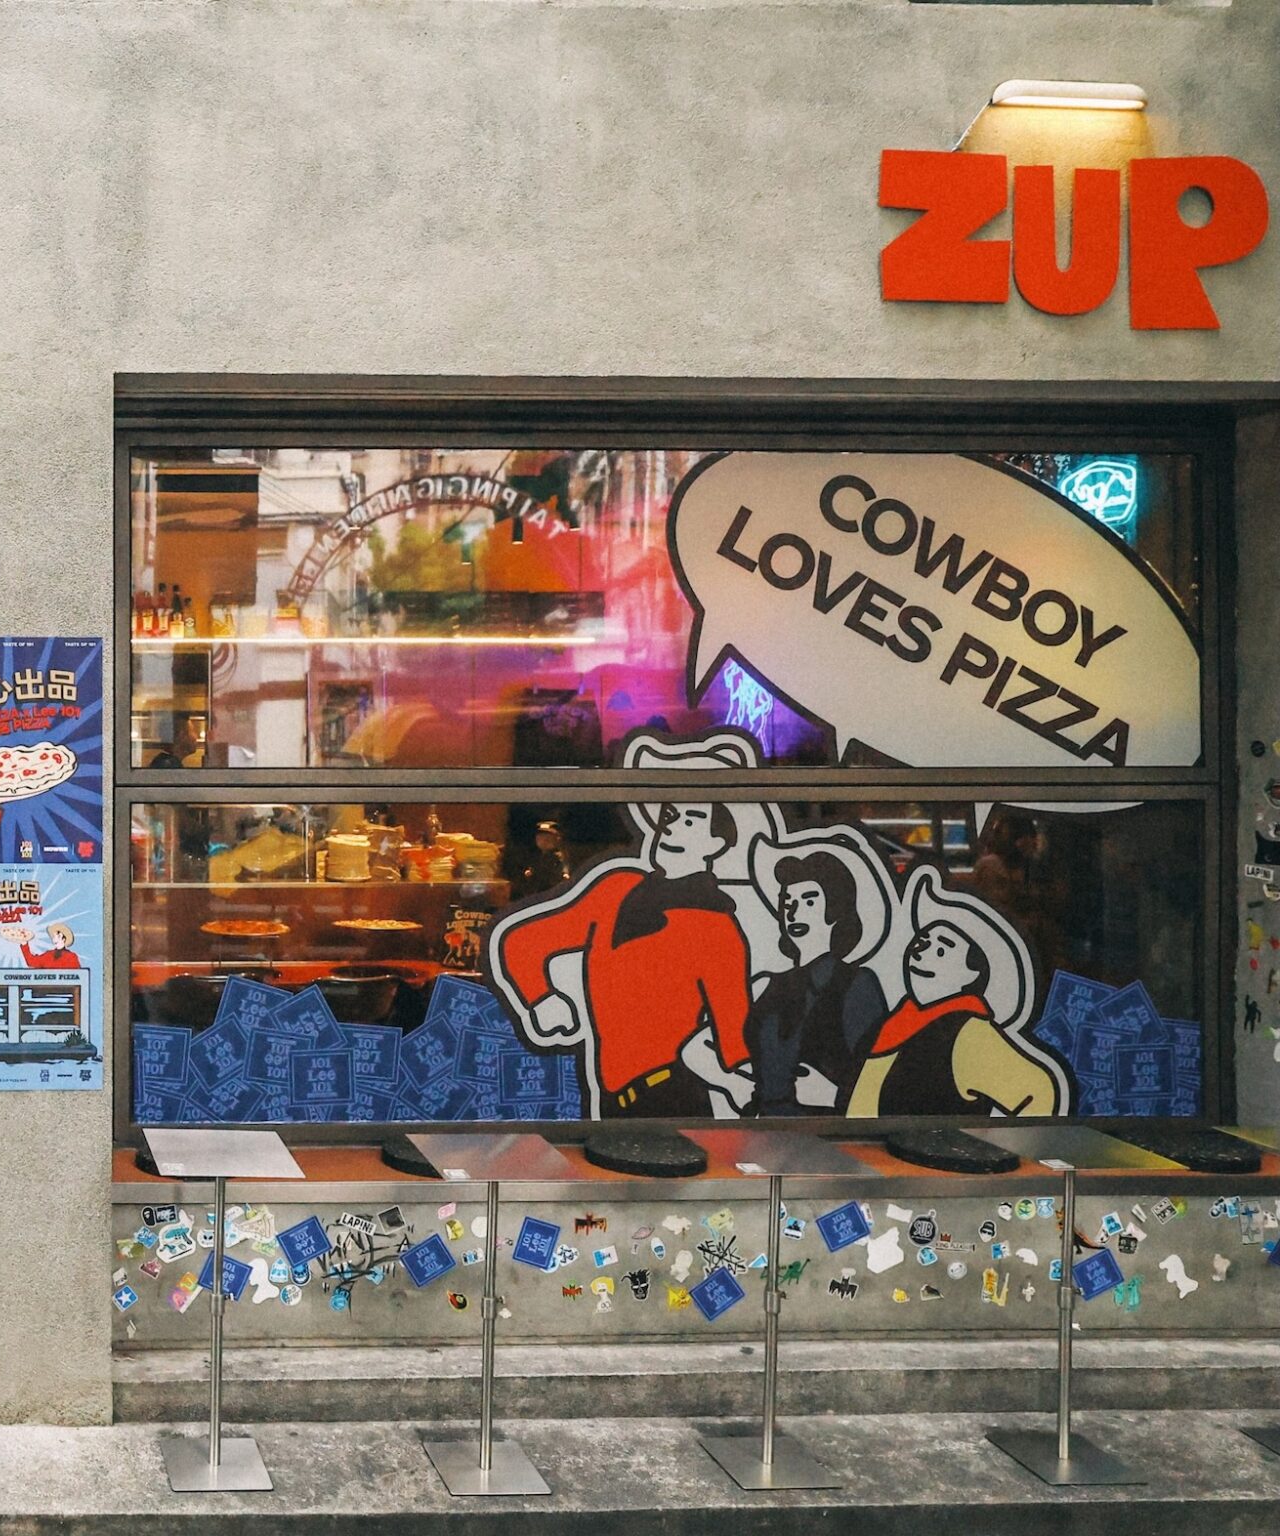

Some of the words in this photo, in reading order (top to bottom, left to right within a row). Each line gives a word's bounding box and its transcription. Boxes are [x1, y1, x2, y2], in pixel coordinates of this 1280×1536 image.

[879, 149, 1269, 330] ZUP
[819, 474, 1128, 669] COWBOY
[716, 505, 943, 663] LOVES
[939, 631, 1130, 767] PIZZA
[248, 990, 267, 1004] 101
[239, 1000, 268, 1016] Lee
[311, 1058, 332, 1068] 101
[521, 1057, 542, 1067] 101
[306, 1069, 336, 1081] Lee
[516, 1068, 546, 1080] Lee
[312, 1081, 332, 1092] 101
[522, 1080, 542, 1091] 101
[913, 1221, 933, 1237] SUB
